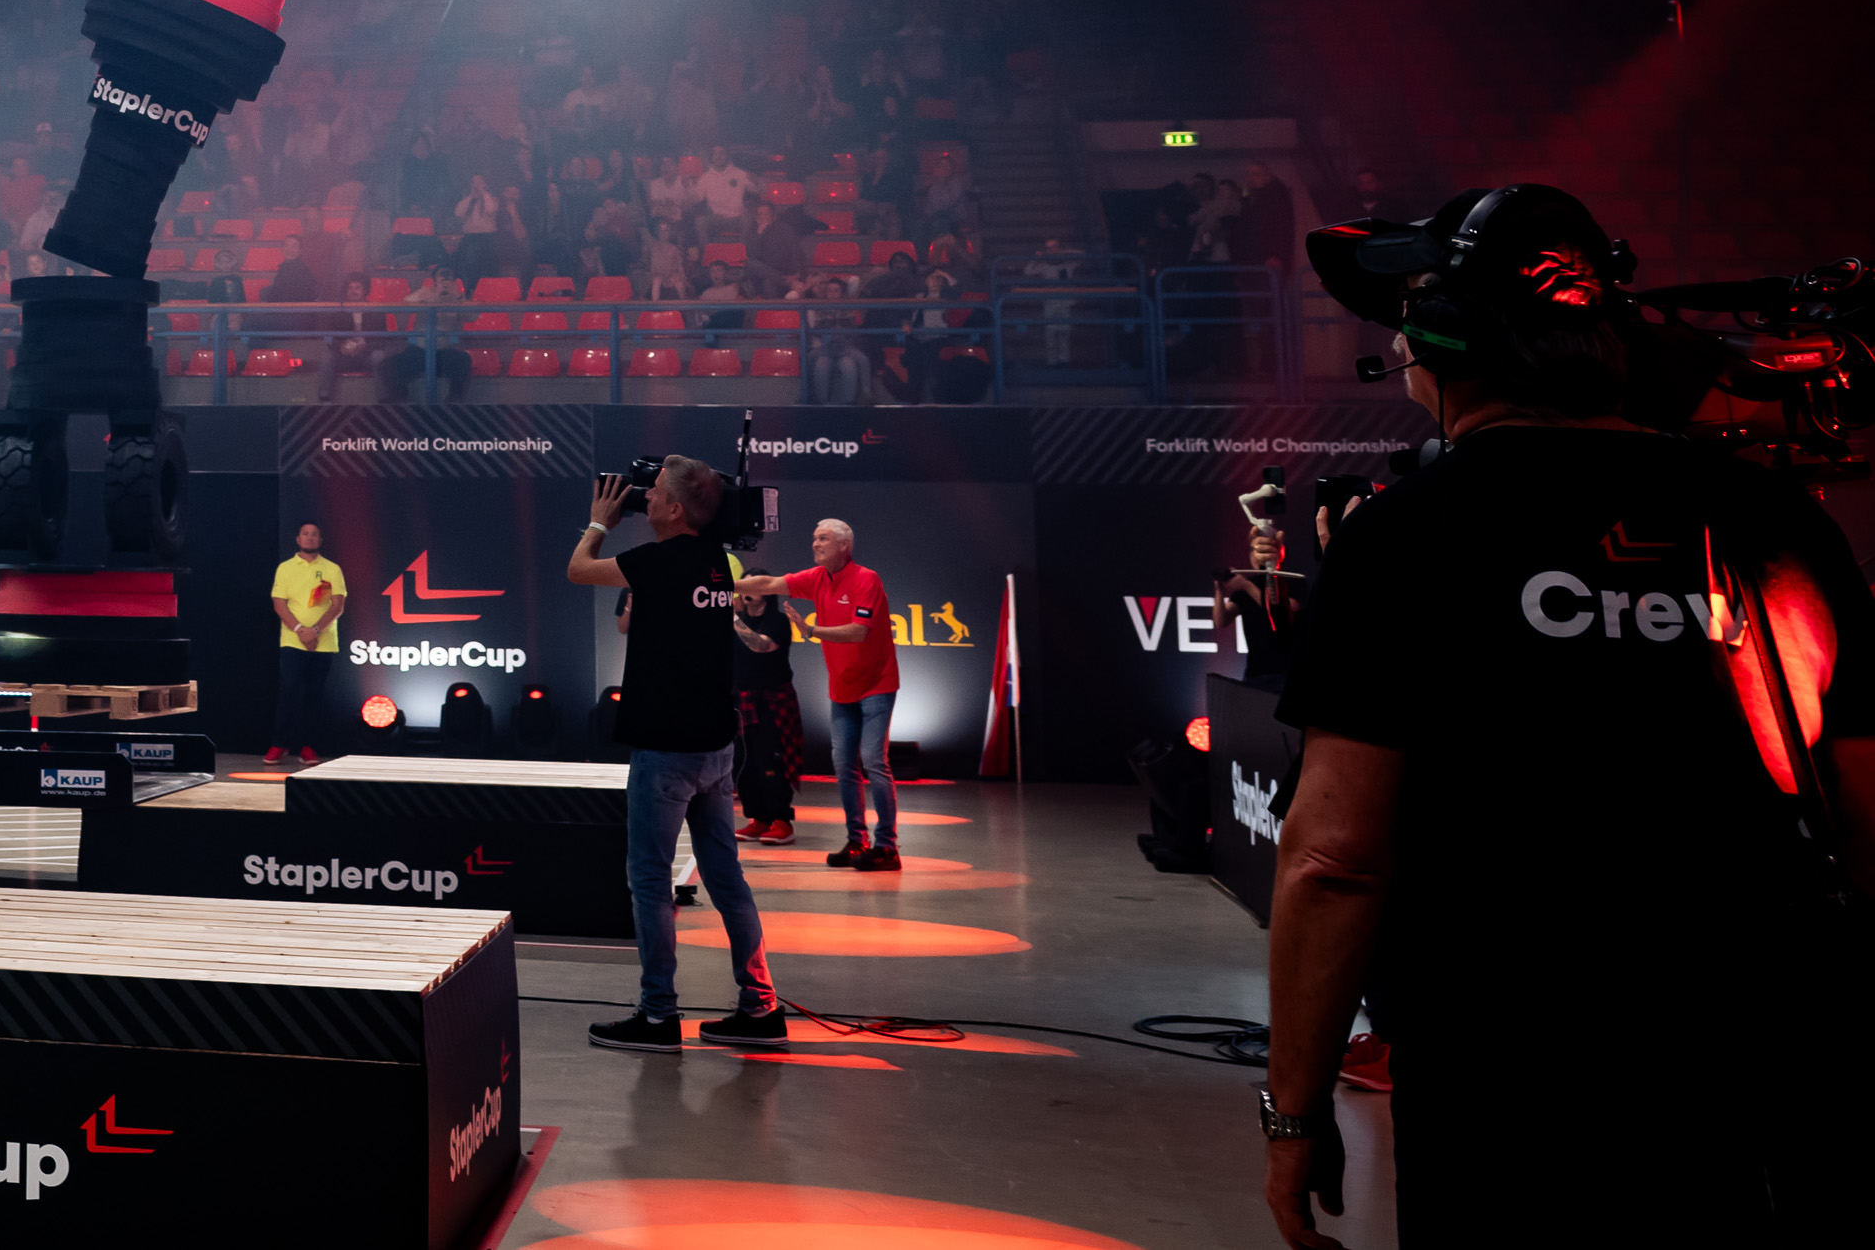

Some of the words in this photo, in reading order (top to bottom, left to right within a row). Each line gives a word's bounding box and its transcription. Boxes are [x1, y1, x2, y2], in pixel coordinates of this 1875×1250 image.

[93, 77, 209, 146] StaplerCup
[321, 437, 378, 452] Forklift
[381, 437, 429, 452] World
[432, 437, 553, 454] Championship
[737, 437, 860, 458] StaplerCup
[1145, 437, 1210, 454] Forklift
[1212, 437, 1269, 454] World
[349, 639, 527, 674] StaplerCup
[133, 749, 173, 758] KAUP
[60, 775, 104, 786] KAUP
[242, 854, 460, 901] StaplerCup
[449, 1085, 502, 1183] StaplerCup
